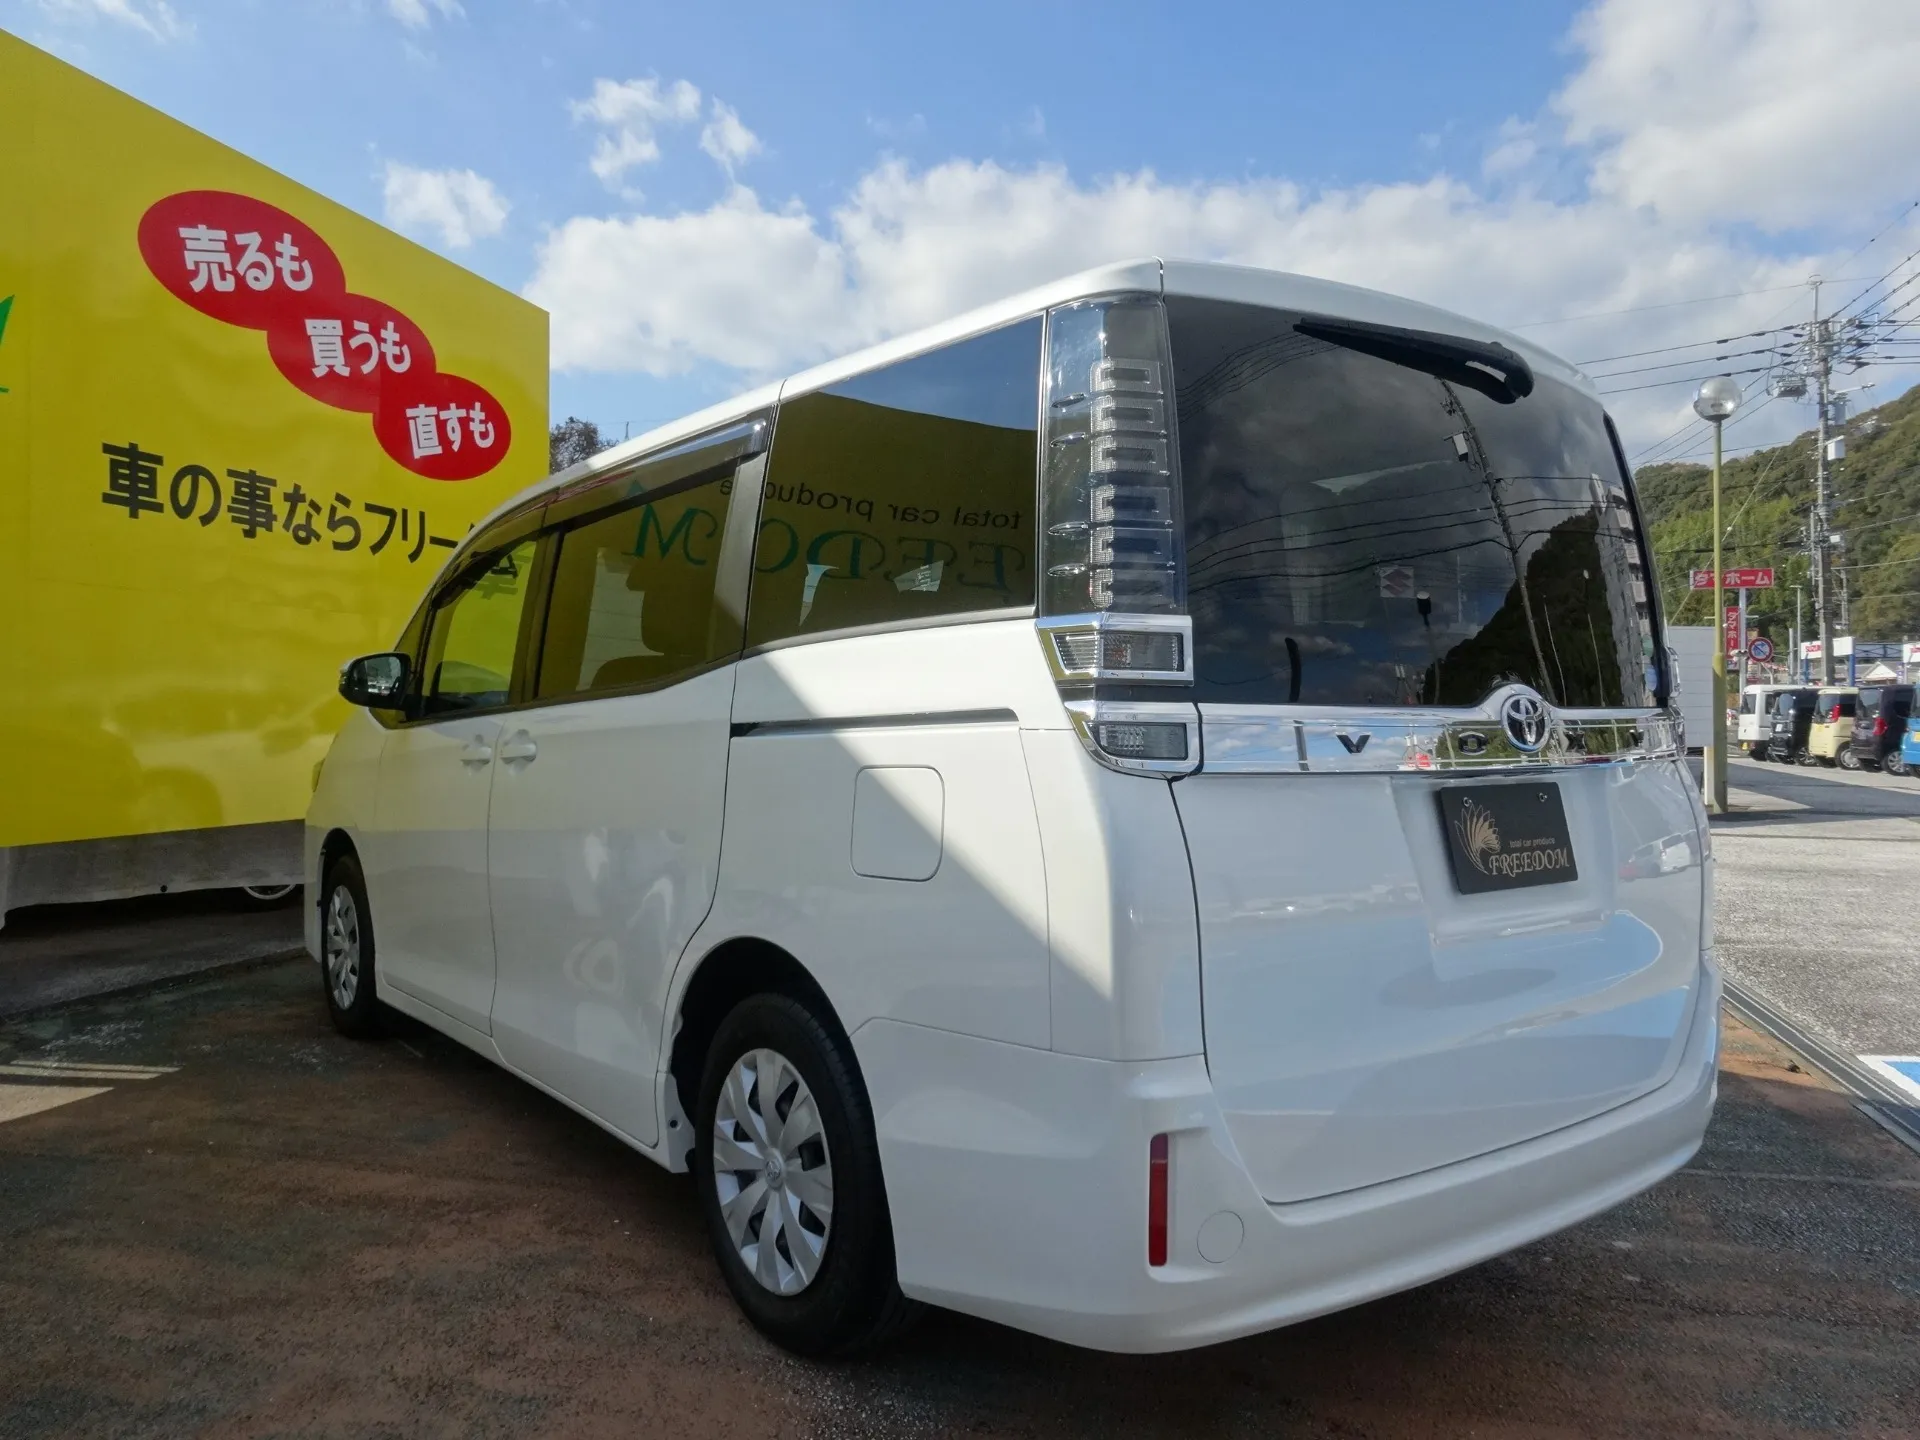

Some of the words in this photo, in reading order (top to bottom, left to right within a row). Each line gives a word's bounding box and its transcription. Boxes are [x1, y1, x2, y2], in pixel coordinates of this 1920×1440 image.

[178, 223, 313, 293] 売るも
[304, 318, 412, 379] 買うも
[405, 401, 495, 459] 直すも
[102, 442, 518, 578] 車の事ならフリー
[1489, 847, 1570, 878] FREEDOM
